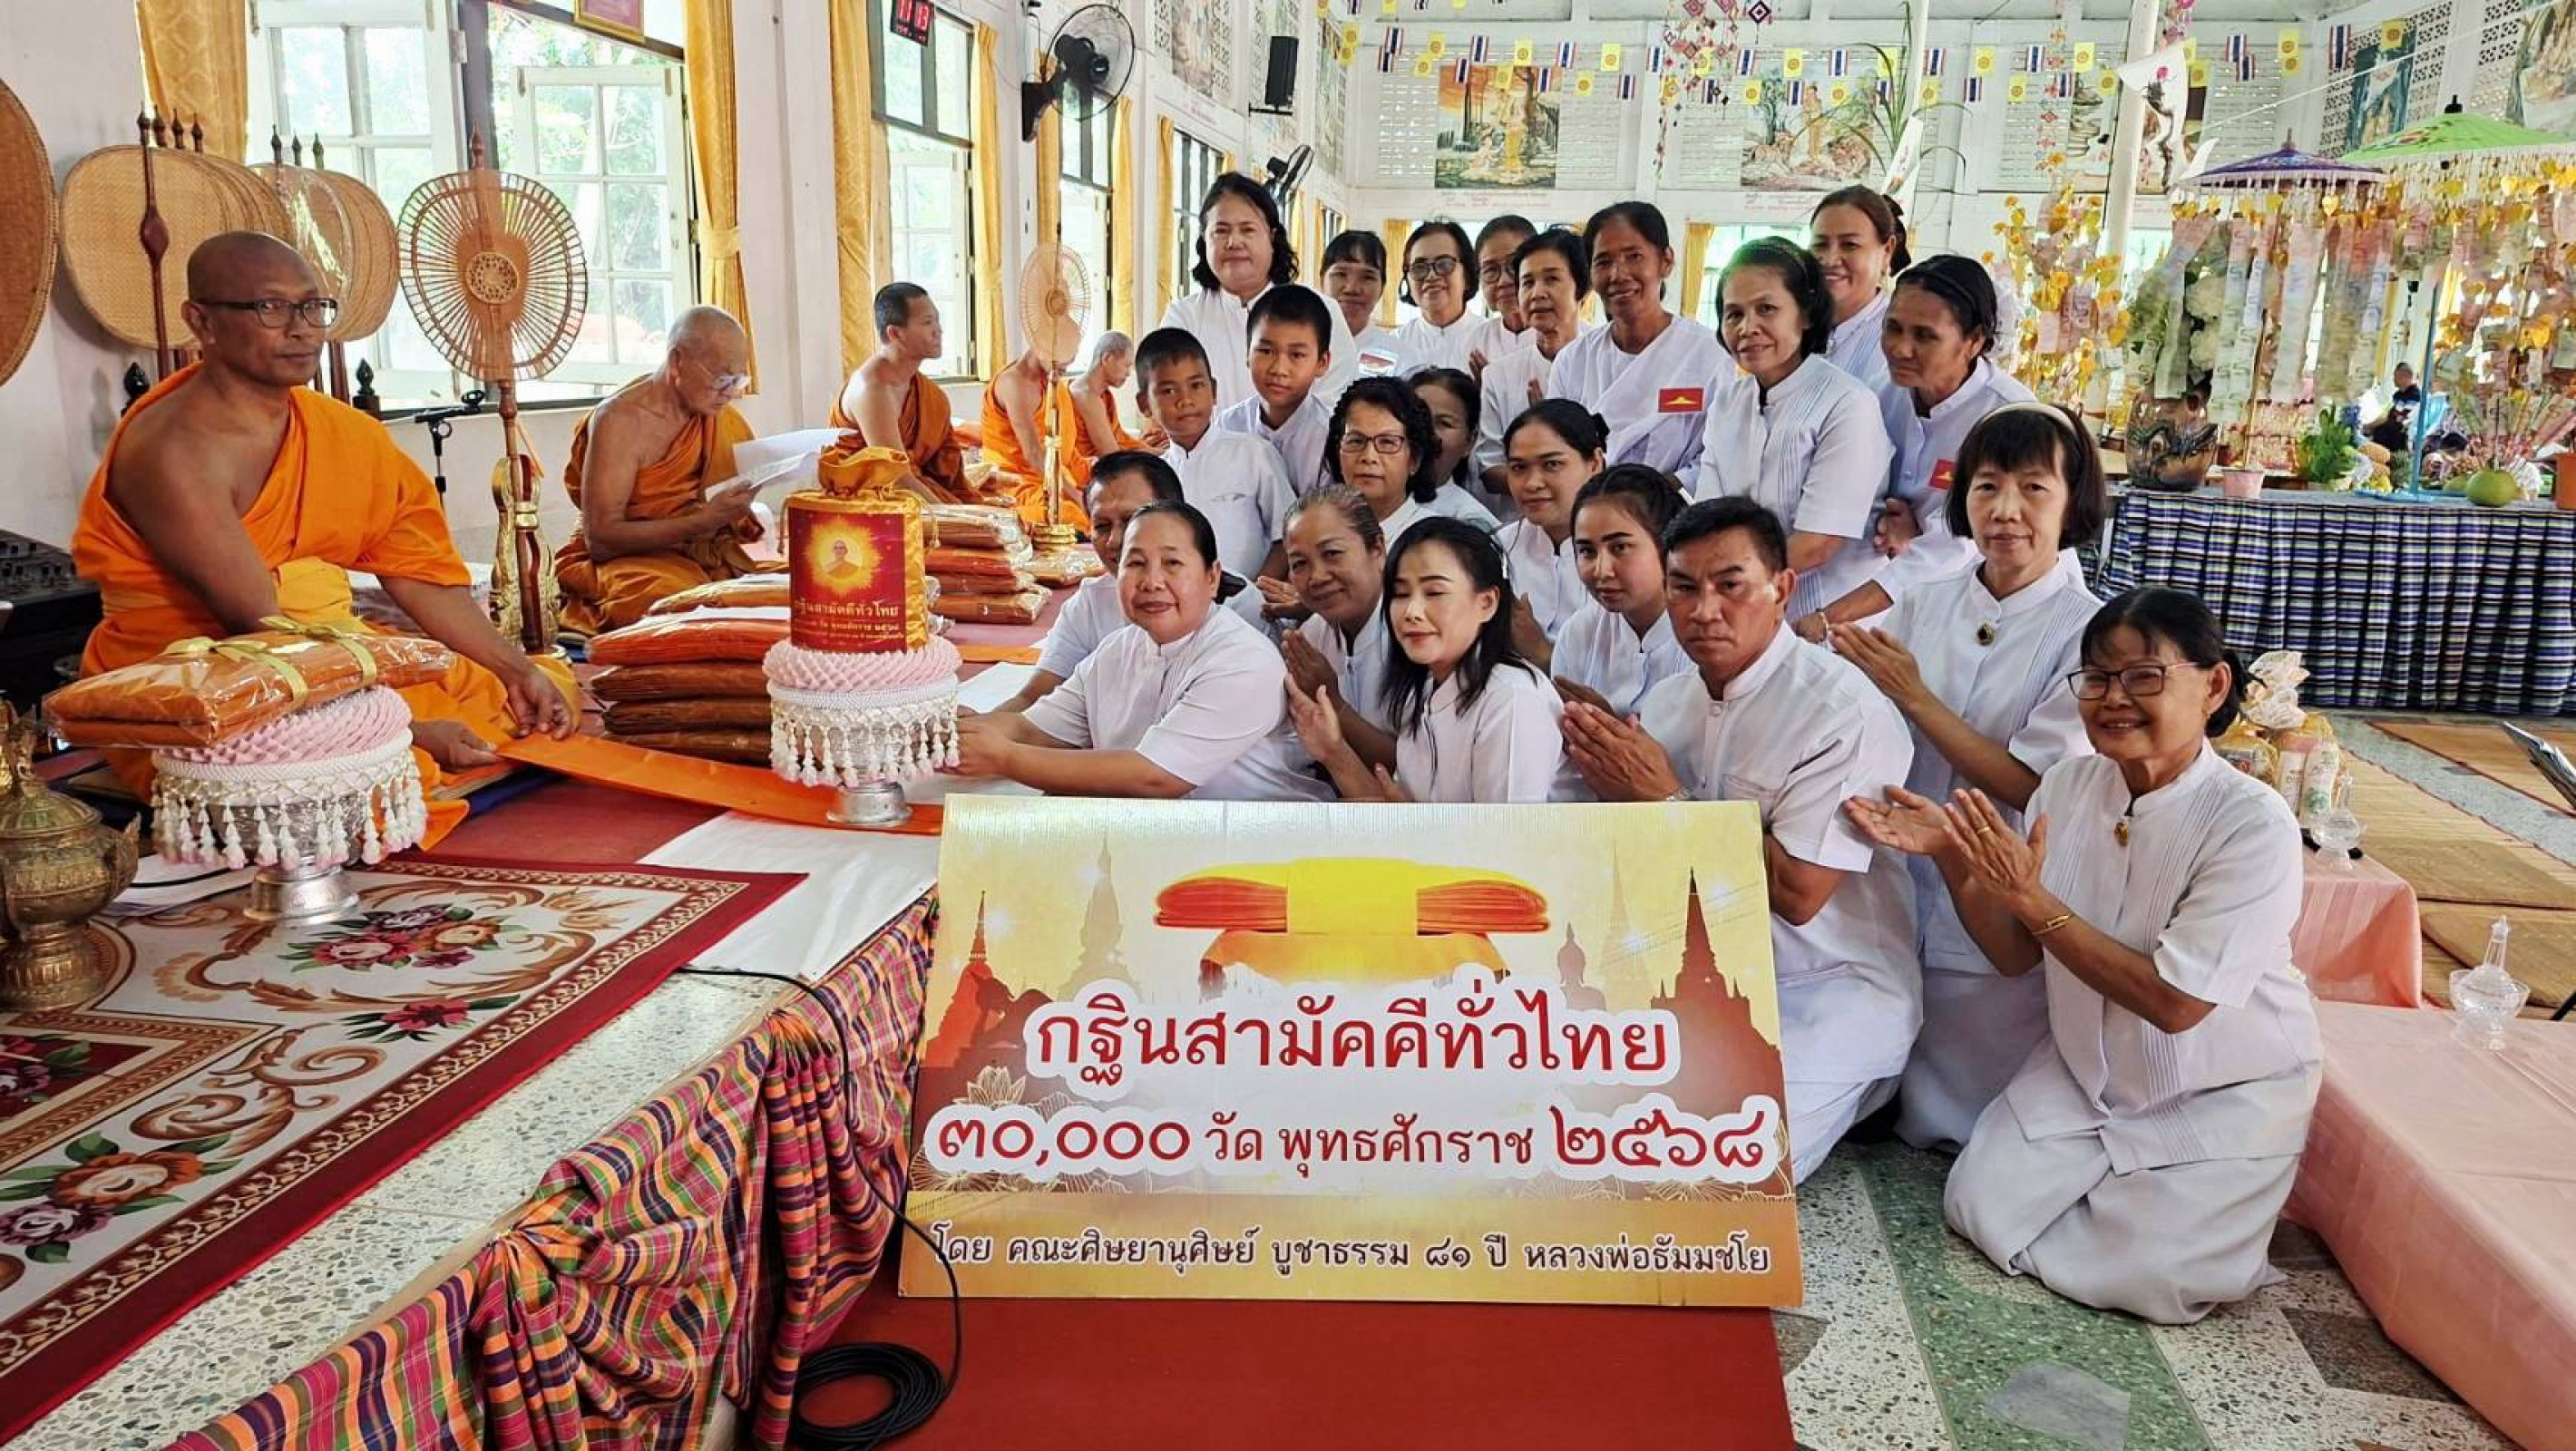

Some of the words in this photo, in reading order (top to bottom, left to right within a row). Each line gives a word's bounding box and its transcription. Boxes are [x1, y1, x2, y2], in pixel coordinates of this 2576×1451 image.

[1038, 979, 1665, 1086] กฐินสามัคคีทั่วไทย
[938, 1118, 1191, 1167] ๓๐,๐๐๐
[1204, 1112, 1263, 1162] วัด
[1278, 1113, 1535, 1179] พุทธศักราช
[1549, 1105, 1766, 1169] ๒๕๖๘
[932, 1222, 991, 1263] โดย
[1007, 1226, 1261, 1273] คณะศิษยานุศิษย์
[1272, 1237, 1409, 1275] บูชาธรรม
[1425, 1237, 1471, 1268] ๘๑
[1485, 1233, 1508, 1267] ปี
[1525, 1232, 1769, 1271] หลวงพ่อธัมมชโย
